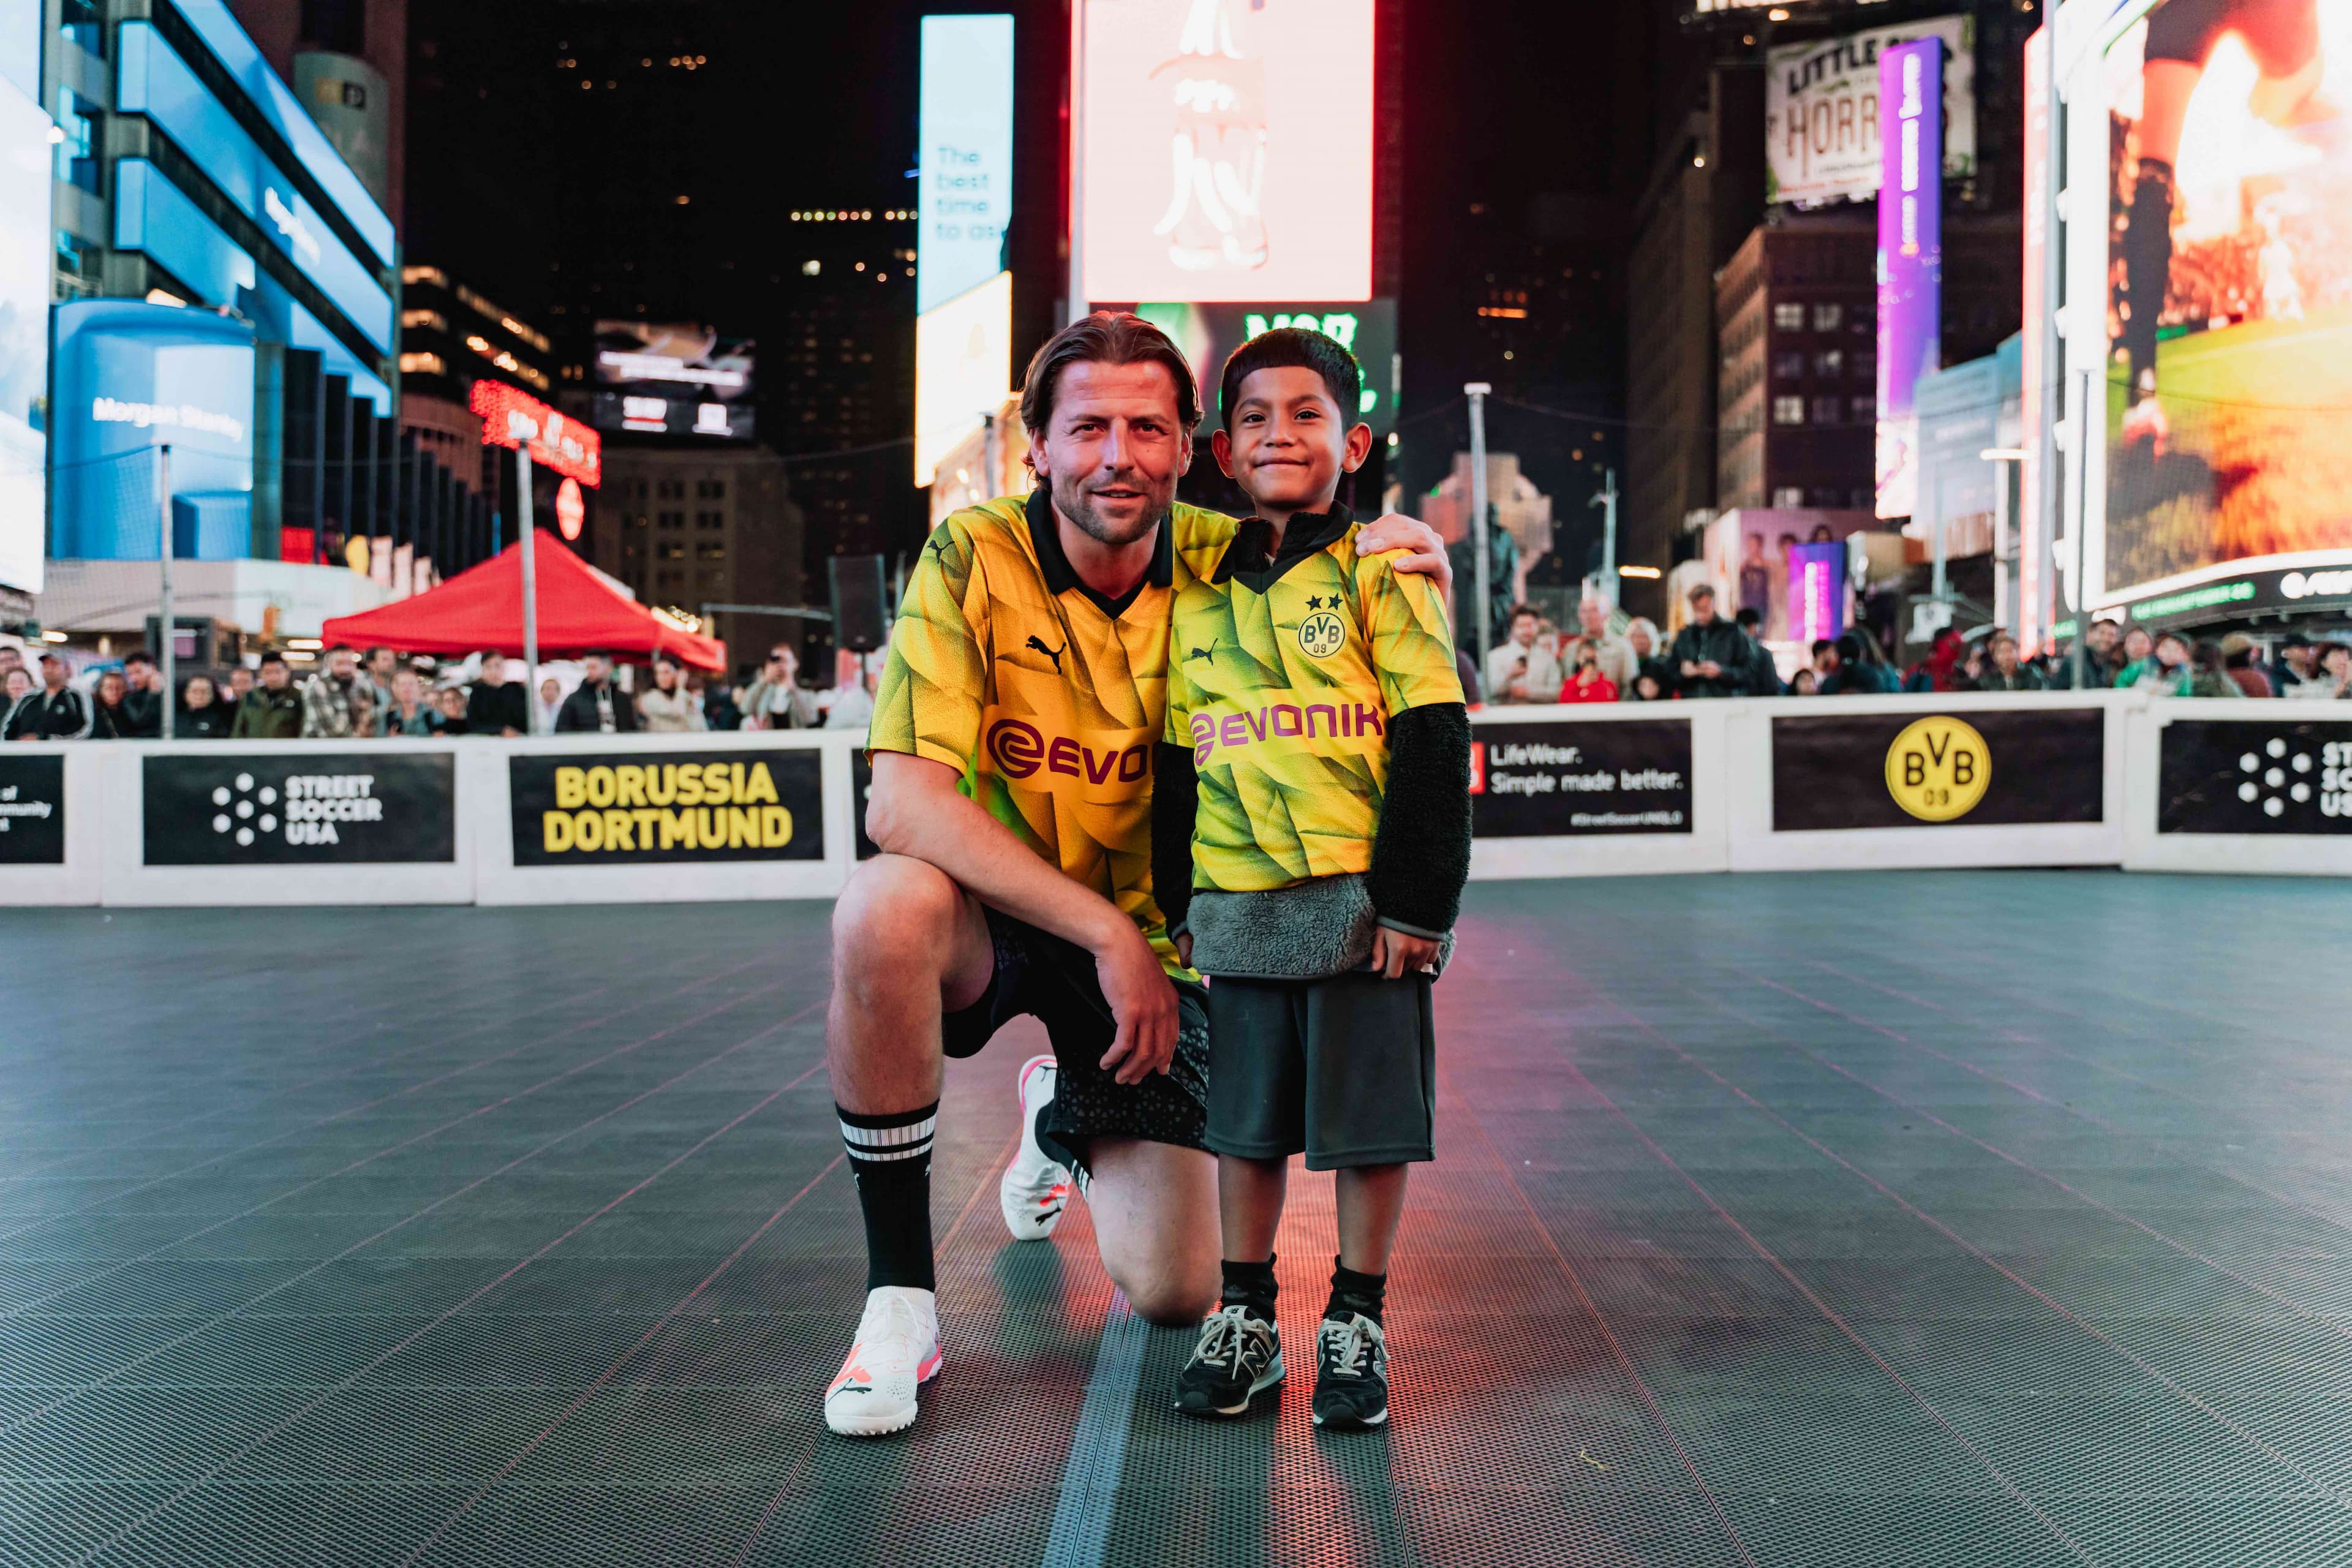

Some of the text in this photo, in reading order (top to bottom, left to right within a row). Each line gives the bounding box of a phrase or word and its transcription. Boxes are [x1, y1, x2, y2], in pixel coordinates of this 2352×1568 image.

[1785, 93, 1879, 181] HORR
[937, 145, 981, 166] The
[937, 172, 989, 192] best
[937, 197, 990, 216] time
[937, 224, 962, 241] to
[1304, 616, 1340, 644] BVB
[1313, 644, 1327, 654] 09
[1220, 703, 1383, 747] EVONIK
[1048, 736, 1158, 785] EVO
[1490, 743, 1583, 766] LifeWear.
[1905, 731, 1974, 786] BVB
[285, 775, 374, 799] STREET
[555, 761, 780, 809] BORUSSIA
[1490, 767, 1684, 797] Simple made better.
[285, 797, 383, 822] SOCCER
[285, 821, 340, 845] USA
[543, 805, 793, 852] DORTMUND
